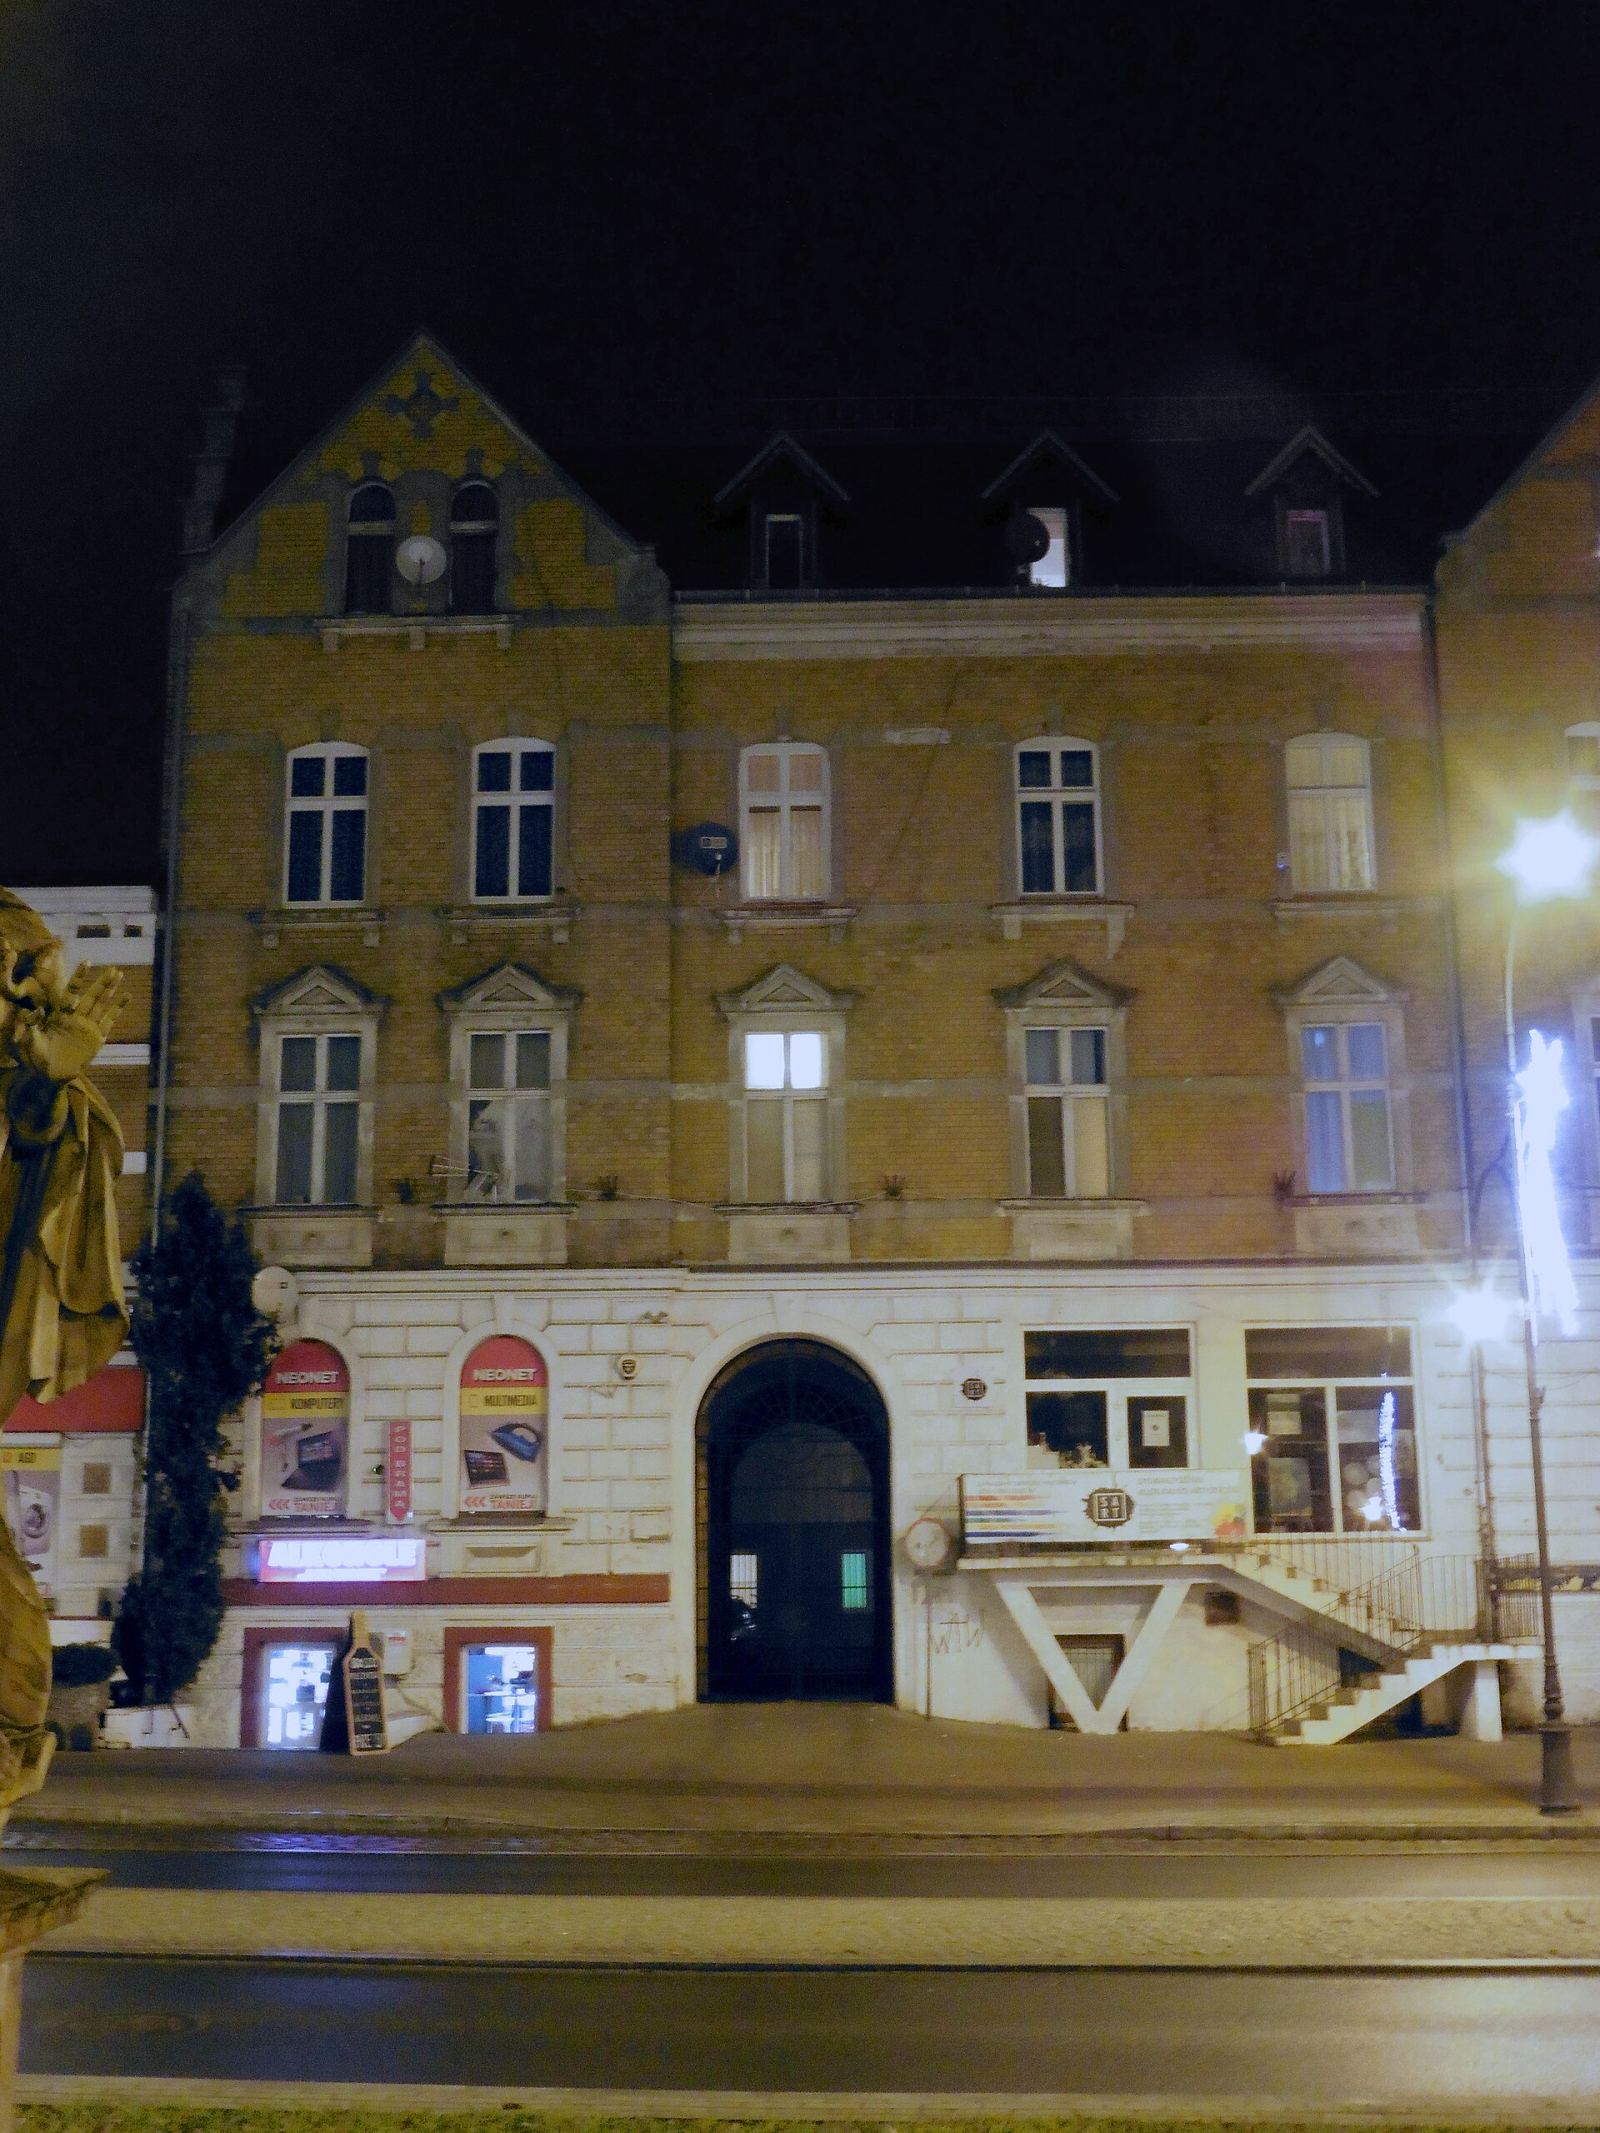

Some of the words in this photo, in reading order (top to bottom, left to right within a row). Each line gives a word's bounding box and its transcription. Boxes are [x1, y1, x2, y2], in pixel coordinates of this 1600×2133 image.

[275, 1371, 339, 1384] NEONET
[473, 1368, 537, 1382] NEONET
[484, 1394, 538, 1408] MULTIMEDIA
